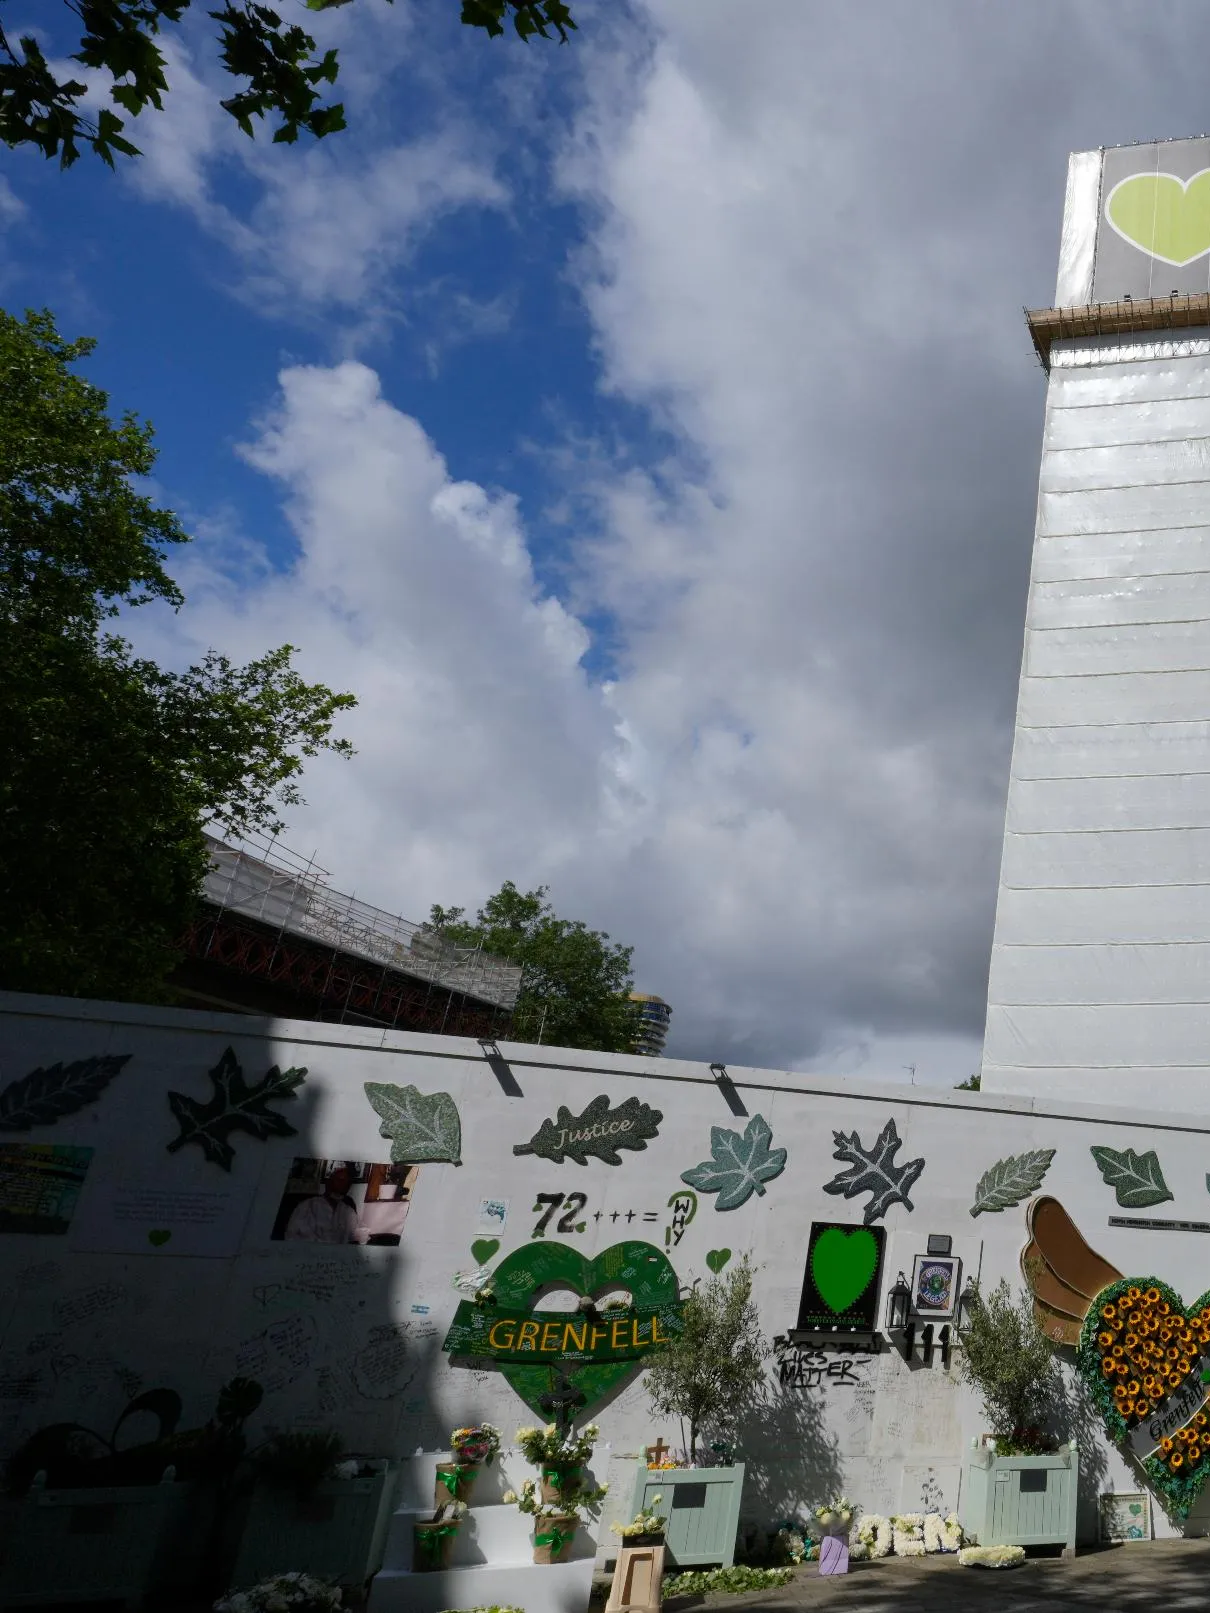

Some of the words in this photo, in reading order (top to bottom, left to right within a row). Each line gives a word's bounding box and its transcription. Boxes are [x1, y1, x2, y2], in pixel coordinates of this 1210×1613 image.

[553, 1119, 635, 1150] Justice
[533, 1191, 588, 1234] 72
[488, 1315, 671, 1352] GRENFELL
[780, 1359, 860, 1385] MATTER
